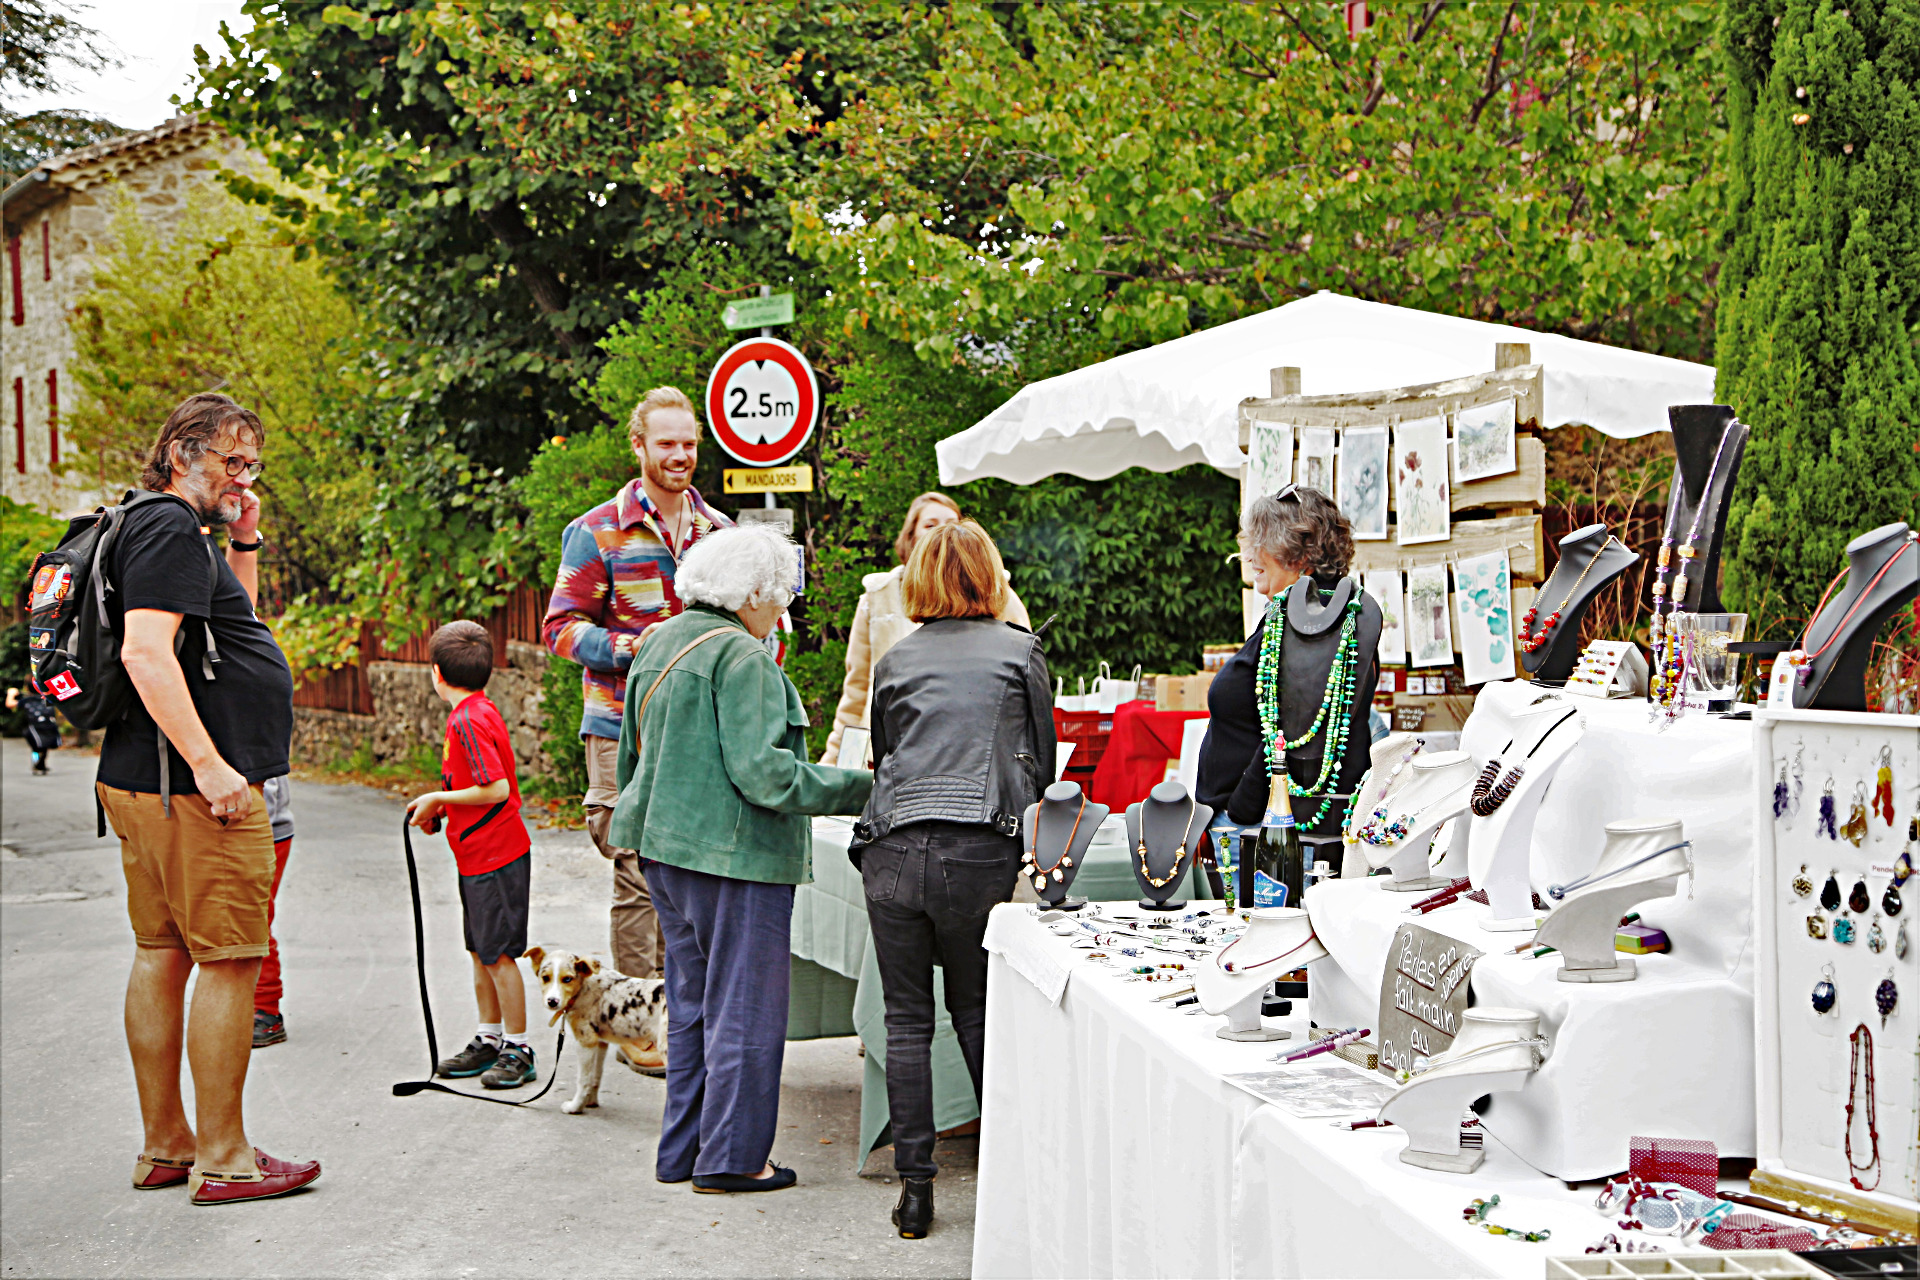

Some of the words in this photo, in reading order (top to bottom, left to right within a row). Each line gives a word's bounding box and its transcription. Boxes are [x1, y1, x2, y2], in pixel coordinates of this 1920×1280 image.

[730, 387, 794, 418] 2.5m
[745, 473, 797, 487] MANDAJORS
[1398, 931, 1437, 988] Perles
[1438, 946, 1457, 975] en
[1442, 952, 1472, 1001] verre
[1395, 975, 1414, 1012] fait
[1417, 999, 1457, 1034] main
[1410, 1028, 1430, 1055] au
